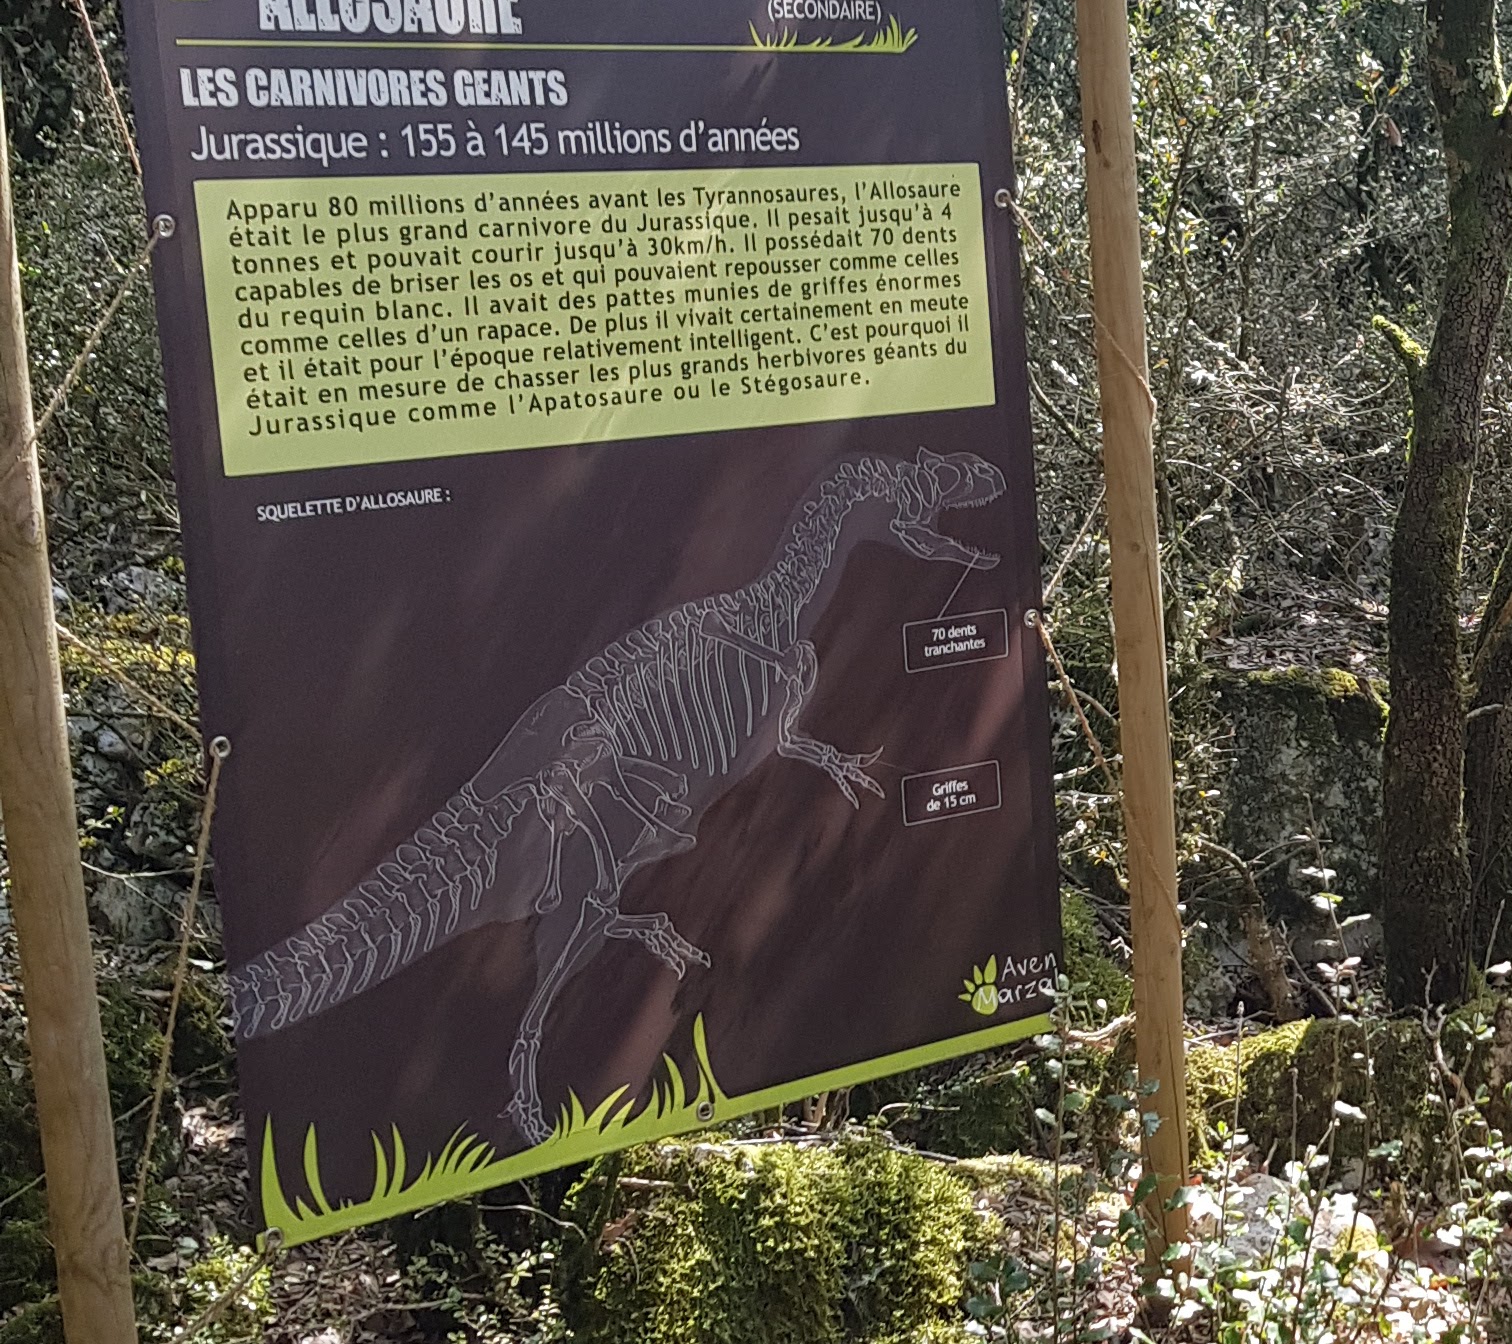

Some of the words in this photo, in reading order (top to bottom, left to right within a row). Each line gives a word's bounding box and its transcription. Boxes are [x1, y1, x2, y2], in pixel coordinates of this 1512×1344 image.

[179, 68, 239, 106] LES
[245, 68, 447, 108] CARNIVORES
[453, 68, 568, 106] GEANTS
[190, 126, 367, 167] Jurassique
[378, 131, 388, 158] :
[401, 123, 456, 158] 155
[467, 121, 486, 155] à
[495, 121, 550, 155] 145
[557, 121, 671, 155] millions
[679, 118, 801, 155] d'années
[225, 198, 318, 226] Apparu
[328, 194, 359, 219] 80
[368, 193, 466, 217] millions
[473, 189, 580, 214] d'années
[588, 189, 649, 210] avant
[656, 186, 686, 208] les
[692, 184, 848, 209] Tyrannosaures,
[854, 179, 961, 201] l'Allosaure
[228, 224, 293, 249] était
[302, 222, 326, 246] le
[336, 221, 390, 250] plus
[398, 217, 469, 247] grand
[478, 215, 592, 242] carnivore
[600, 212, 628, 234] du
[636, 211, 759, 234] Jurassique.
[767, 207, 780, 228] Il
[787, 205, 851, 232] pesait
[858, 203, 934, 227] jusqu'à
[940, 201, 952, 221] 4
[230, 254, 320, 277] tonnes
[330, 249, 358, 272] et
[366, 244, 462, 277] pouvait
[470, 241, 545, 266] courir
[553, 236, 638, 264] jusqu'à
[647, 236, 735, 256] 30km/h.
[744, 231, 757, 253] Il
[765, 227, 863, 257] possédait
[869, 226, 898, 249] 70
[902, 225, 958, 246] dents
[234, 276, 343, 308] capables
[351, 273, 382, 297] de
[389, 271, 460, 295] briser
[469, 268, 502, 291] les
[508, 271, 534, 289] os
[541, 266, 565, 287] et
[571, 263, 606, 291] qui
[614, 259, 718, 292] pouvaient
[724, 256, 822, 282] repousser
[828, 254, 898, 272] comme
[903, 247, 960, 269] celles
[237, 306, 270, 330] du
[280, 301, 365, 332] requin
[374, 298, 453, 322] blanc.
[464, 294, 480, 317] Il
[489, 291, 549, 315] avait
[557, 289, 597, 312] des
[605, 285, 676, 314] pattes
[685, 282, 759, 302] munies
[767, 278, 793, 299] de
[800, 274, 868, 302] griffes
[875, 272, 962, 293] énormes
[240, 334, 329, 357] comme
[337, 325, 408, 351] celles
[415, 322, 469, 346] d'un
[477, 321, 560, 345] rapace.
[569, 314, 598, 336] De
[604, 311, 649, 339] plus
[655, 308, 669, 330] il
[675, 305, 734, 329] vivait
[739, 297, 874, 325] certainement
[879, 299, 903, 316] en
[909, 293, 969, 314] meute
[242, 361, 271, 384] et
[277, 358, 296, 382] il
[303, 354, 363, 380] était
[369, 354, 424, 380] pour
[432, 346, 535, 370] l'époque
[542, 330, 683, 363] relativement
[688, 326, 802, 353] intelligent.
[809, 322, 860, 344] C'est
[865, 314, 951, 344] pourquoi
[957, 312, 970, 333] il
[245, 384, 310, 410] était
[317, 386, 348, 405] en
[359, 380, 447, 401] mesure
[457, 374, 485, 393] de
[493, 368, 581, 391] chasser
[589, 362, 620, 384] les
[628, 358, 673, 386] plus
[680, 351, 750, 381] grands
[757, 345, 866, 370] herbivores
[873, 339, 938, 366] géants
[944, 335, 967, 356] du
[248, 407, 397, 438] Jurassique
[407, 400, 497, 424] comme
[509, 385, 663, 416] l'Apatosaure
[673, 383, 700, 401] ou
[710, 377, 731, 398] le
[740, 371, 870, 397] Stégosaure.
[257, 498, 342, 522] SQUELETTE
[346, 488, 442, 512] D'ALLOSAURE
[445, 490, 451, 501] :
[925, 637, 986, 657] tranchantes
[932, 628, 946, 641] 70
[948, 624, 977, 638] dents
[927, 799, 941, 812] de
[944, 796, 957, 807] 15
[960, 793, 976, 806] cm
[933, 780, 969, 796] Griffes
[977, 968, 1059, 1011] Marzal
[1002, 953, 1056, 982] Aven
